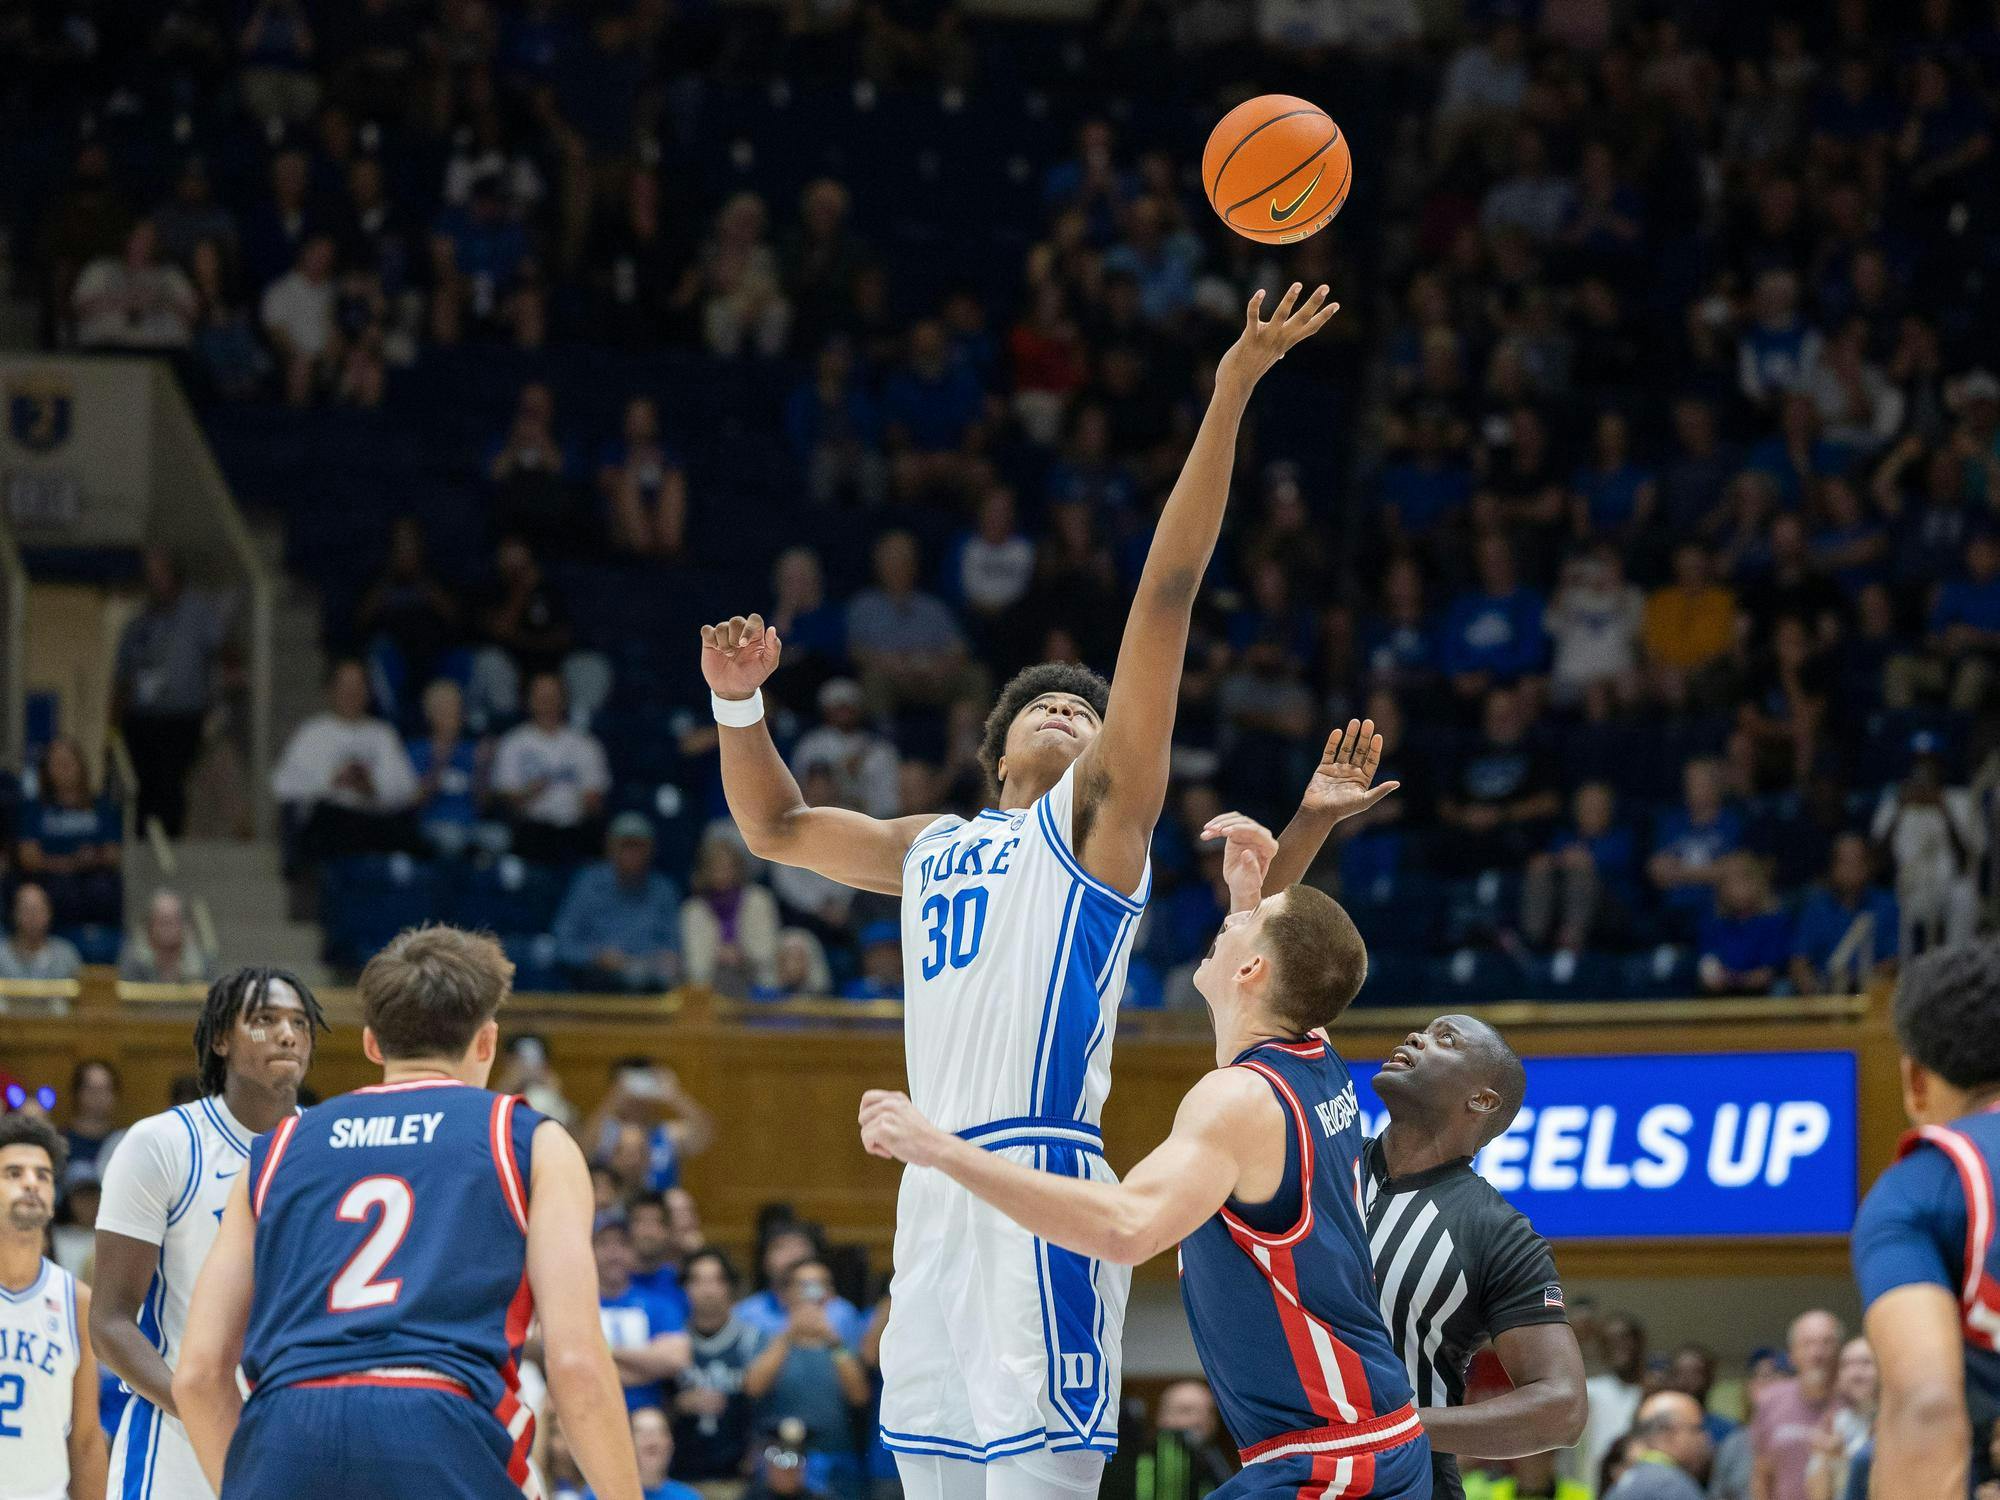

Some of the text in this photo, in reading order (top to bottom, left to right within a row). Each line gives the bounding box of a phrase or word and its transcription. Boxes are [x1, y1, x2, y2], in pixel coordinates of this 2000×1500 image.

[920, 838, 1020, 898] DUKE
[922, 886, 990, 982] 30
[329, 1111, 445, 1149] SMILEY
[1360, 1102, 1694, 1192] EELS
[1706, 1100, 1831, 1189] UP
[327, 1173, 416, 1314] 2
[0, 1373, 25, 1438] 2
